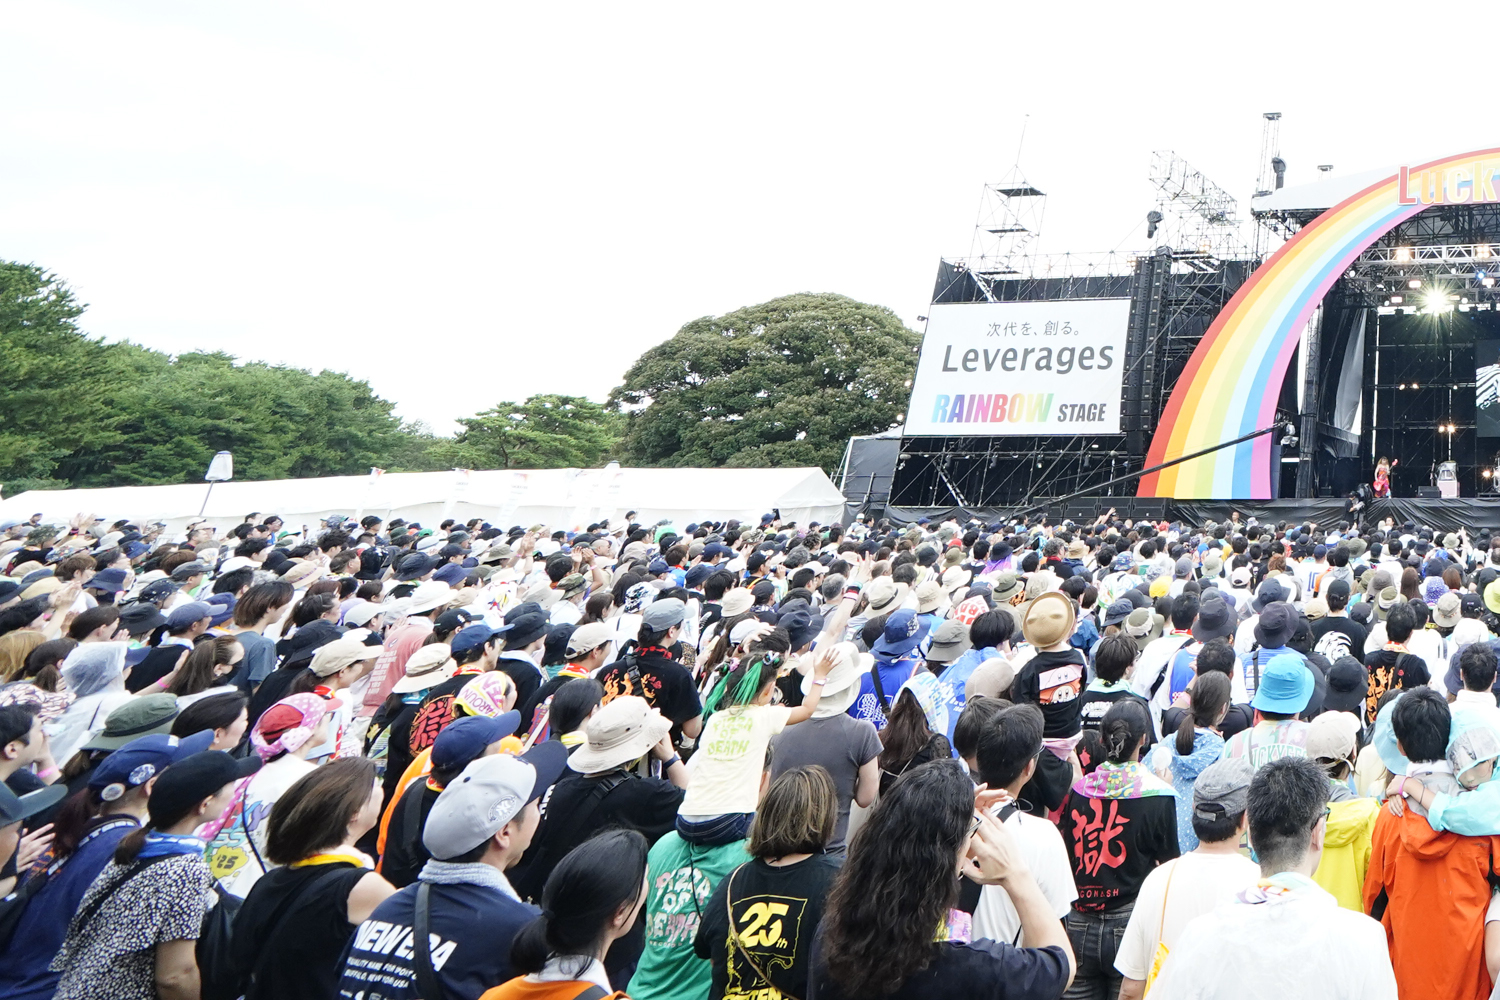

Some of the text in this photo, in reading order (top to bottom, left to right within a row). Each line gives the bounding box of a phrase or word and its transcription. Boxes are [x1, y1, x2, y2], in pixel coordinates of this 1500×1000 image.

[986, 320, 1079, 337] 次代を、創る。
[942, 345, 1114, 374] Leverages
[931, 393, 1107, 423] RAINBOW STAGE
[655, 866, 711, 906] PIZZA
[661, 892, 692, 914] OF
[352, 920, 413, 955] NEW
[393, 978, 410, 988] USA
